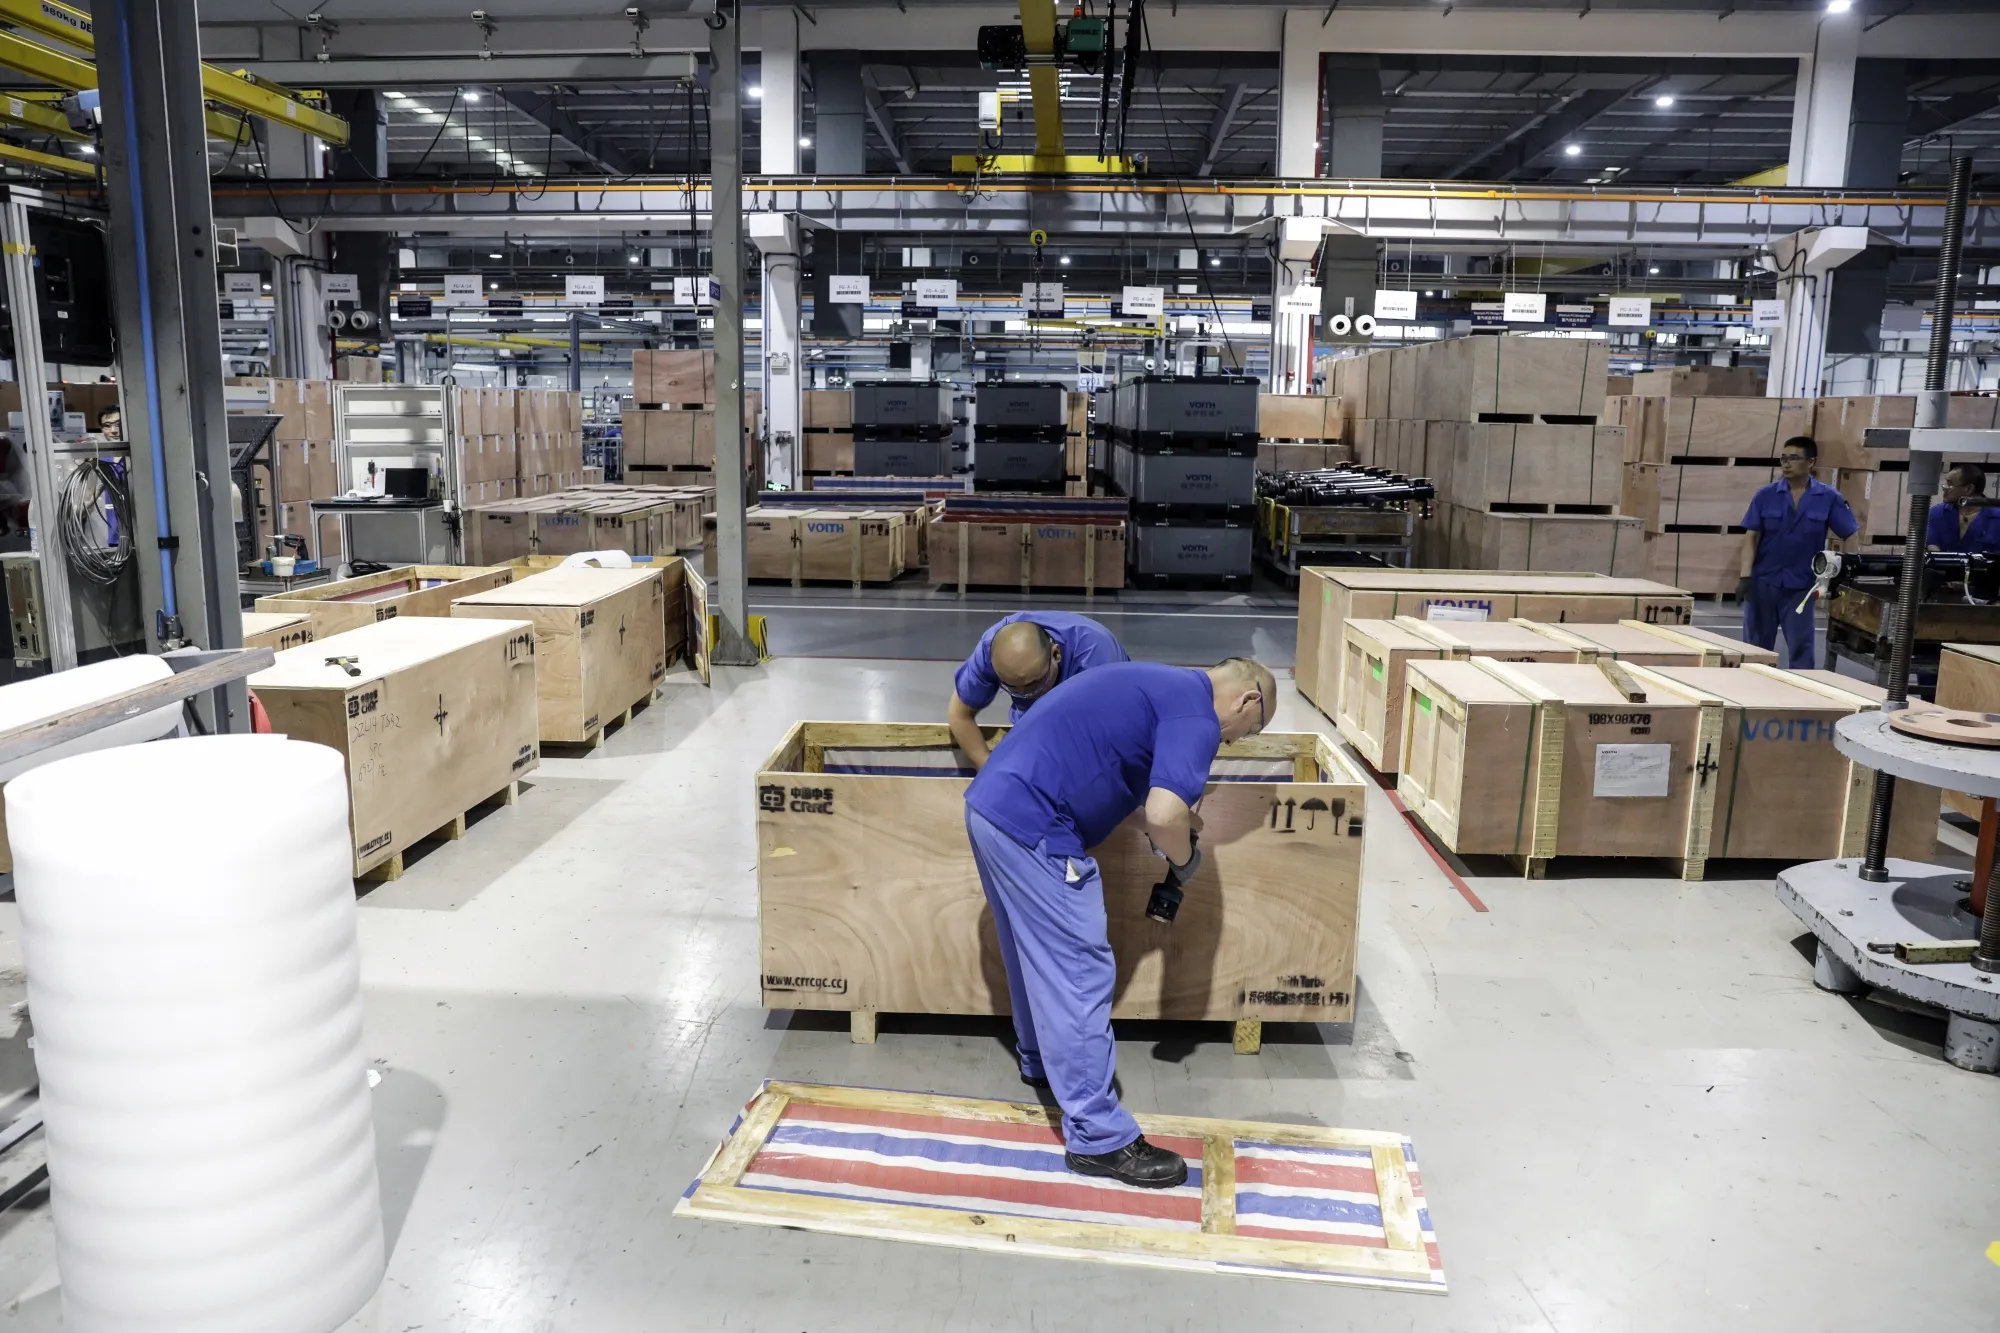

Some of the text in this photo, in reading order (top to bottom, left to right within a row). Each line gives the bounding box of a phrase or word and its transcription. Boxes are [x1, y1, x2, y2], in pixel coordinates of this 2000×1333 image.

[545, 515, 579, 526] VOITH
[807, 523, 845, 533] VOITH
[1037, 528, 1076, 539] VOITH
[1743, 718, 1835, 742] VOITH
[790, 786, 834, 800] 中国中车
[790, 800, 834, 815] CRRC
[766, 975, 843, 990] www.crrcgc.cc
